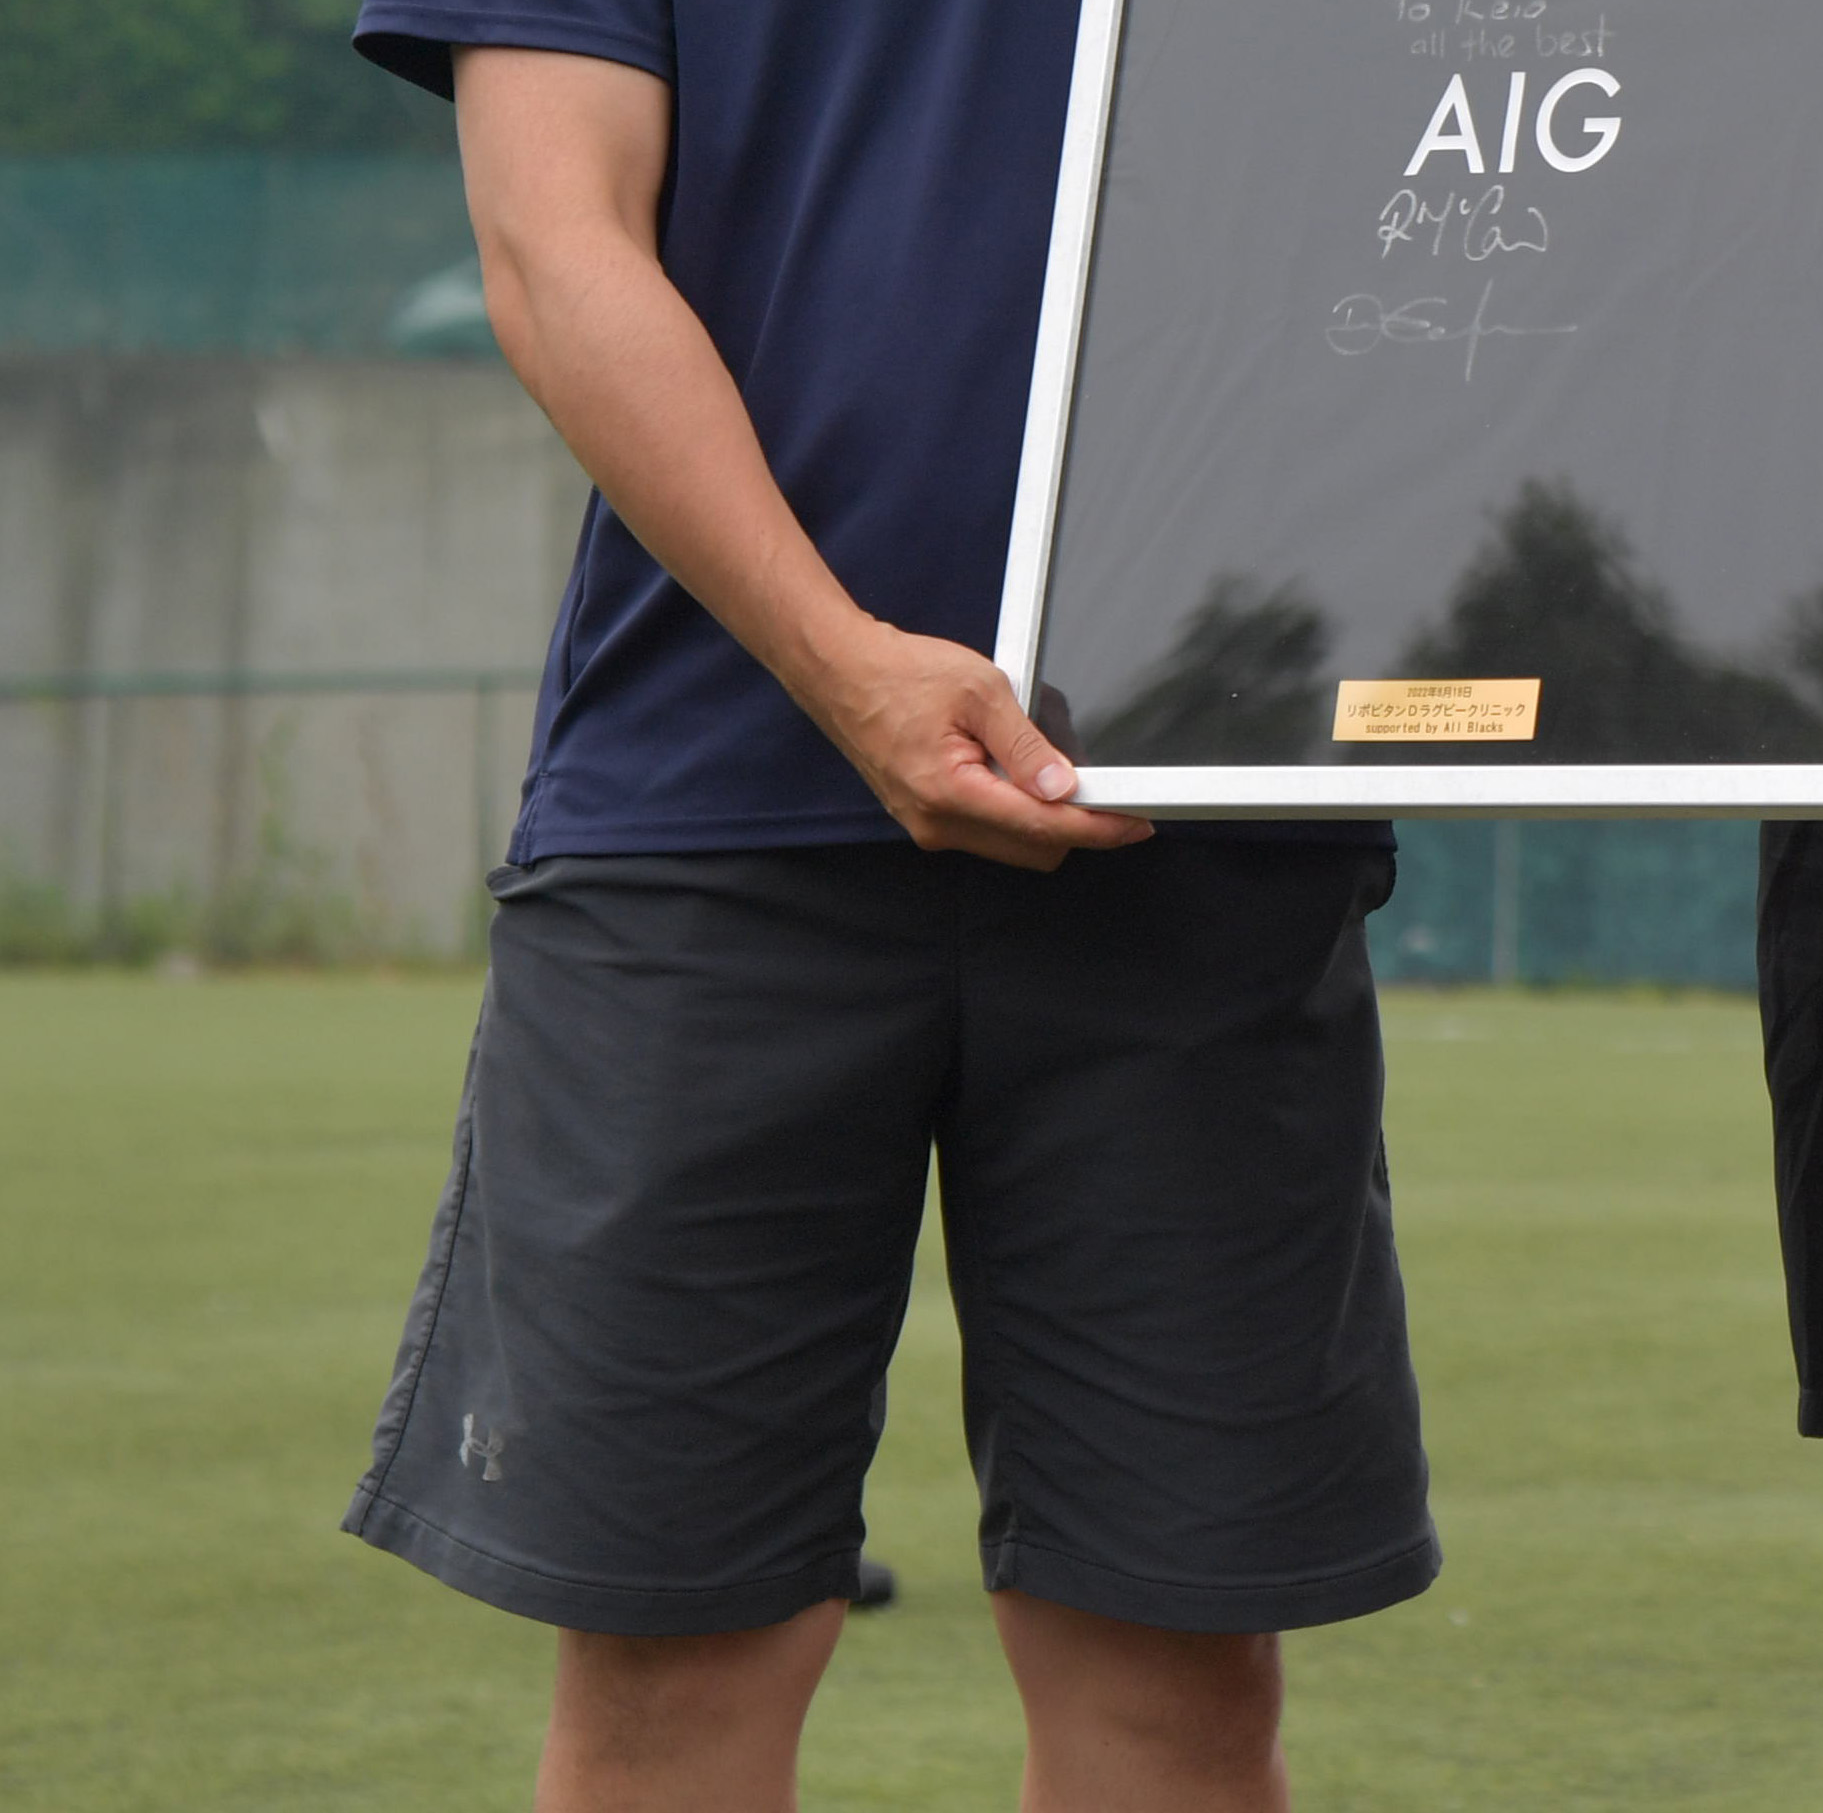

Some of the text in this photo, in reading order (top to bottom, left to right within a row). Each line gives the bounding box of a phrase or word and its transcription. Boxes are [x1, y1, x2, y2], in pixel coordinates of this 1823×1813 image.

[1410, 12, 1616, 61] all the best
[1403, 68, 1622, 176] AIG
[1365, 721, 1504, 735] supported by All Blacks
